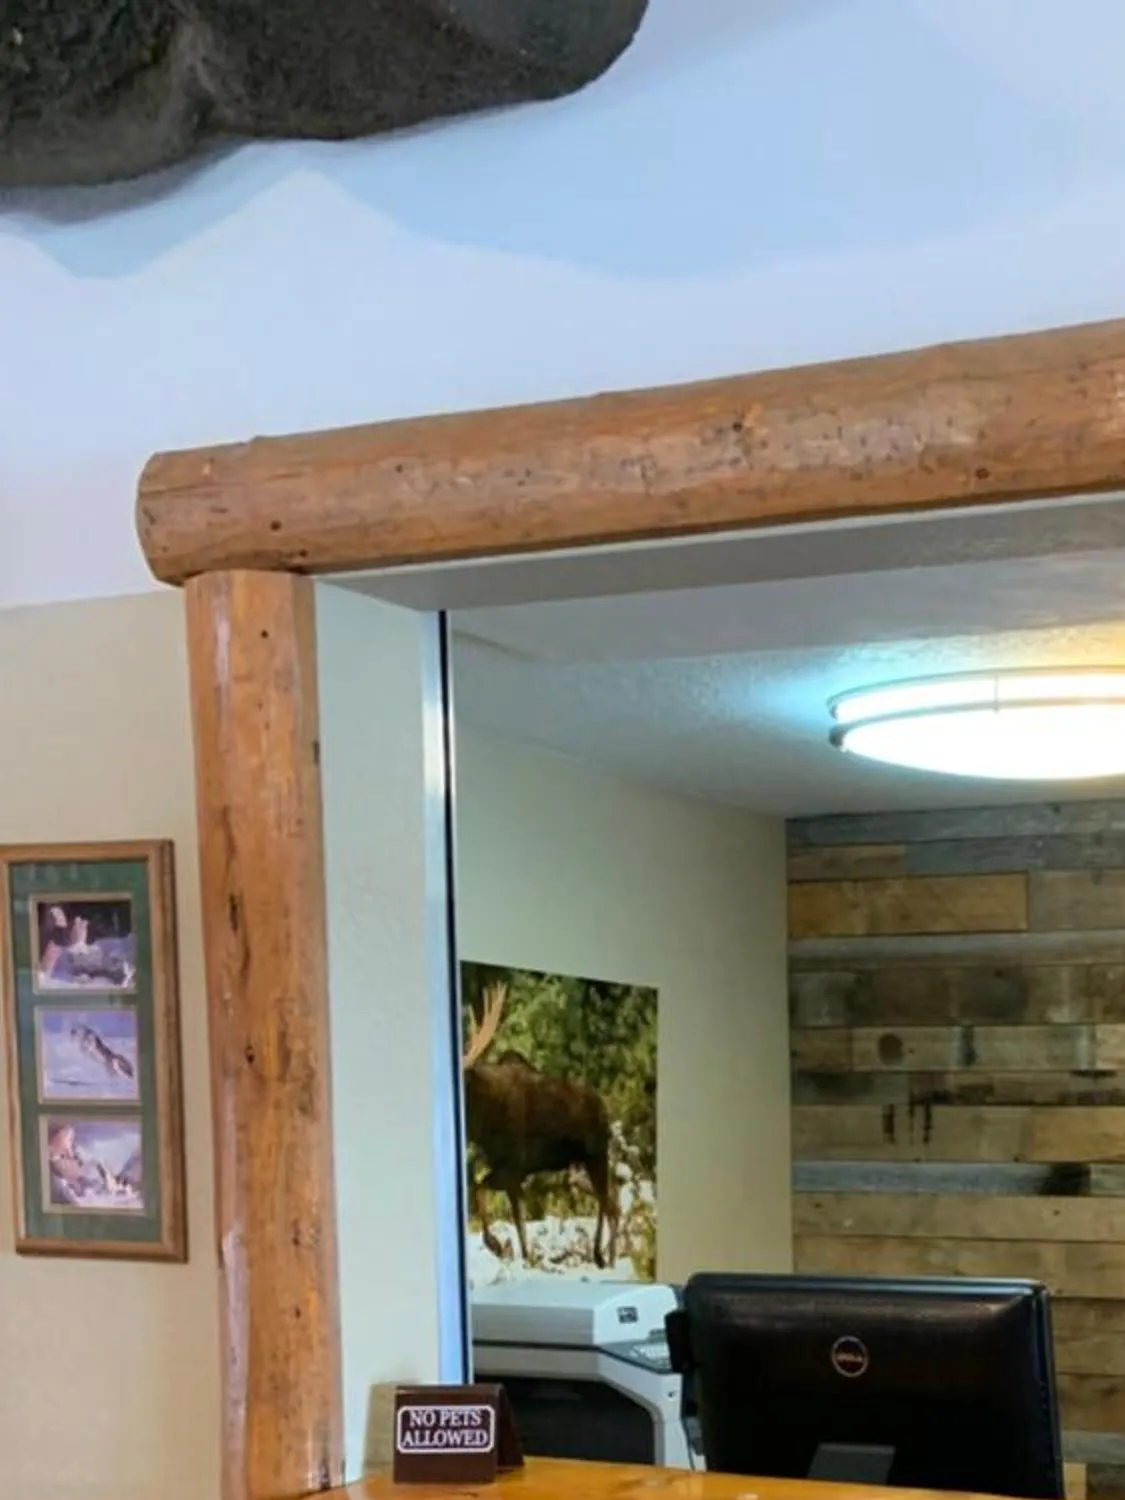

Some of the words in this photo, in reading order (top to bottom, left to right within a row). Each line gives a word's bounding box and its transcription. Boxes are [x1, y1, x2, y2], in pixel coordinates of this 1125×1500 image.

[409, 1410, 437, 1428] NO
[439, 1409, 482, 1427] PETS
[402, 1429, 488, 1447] ALLOWED
